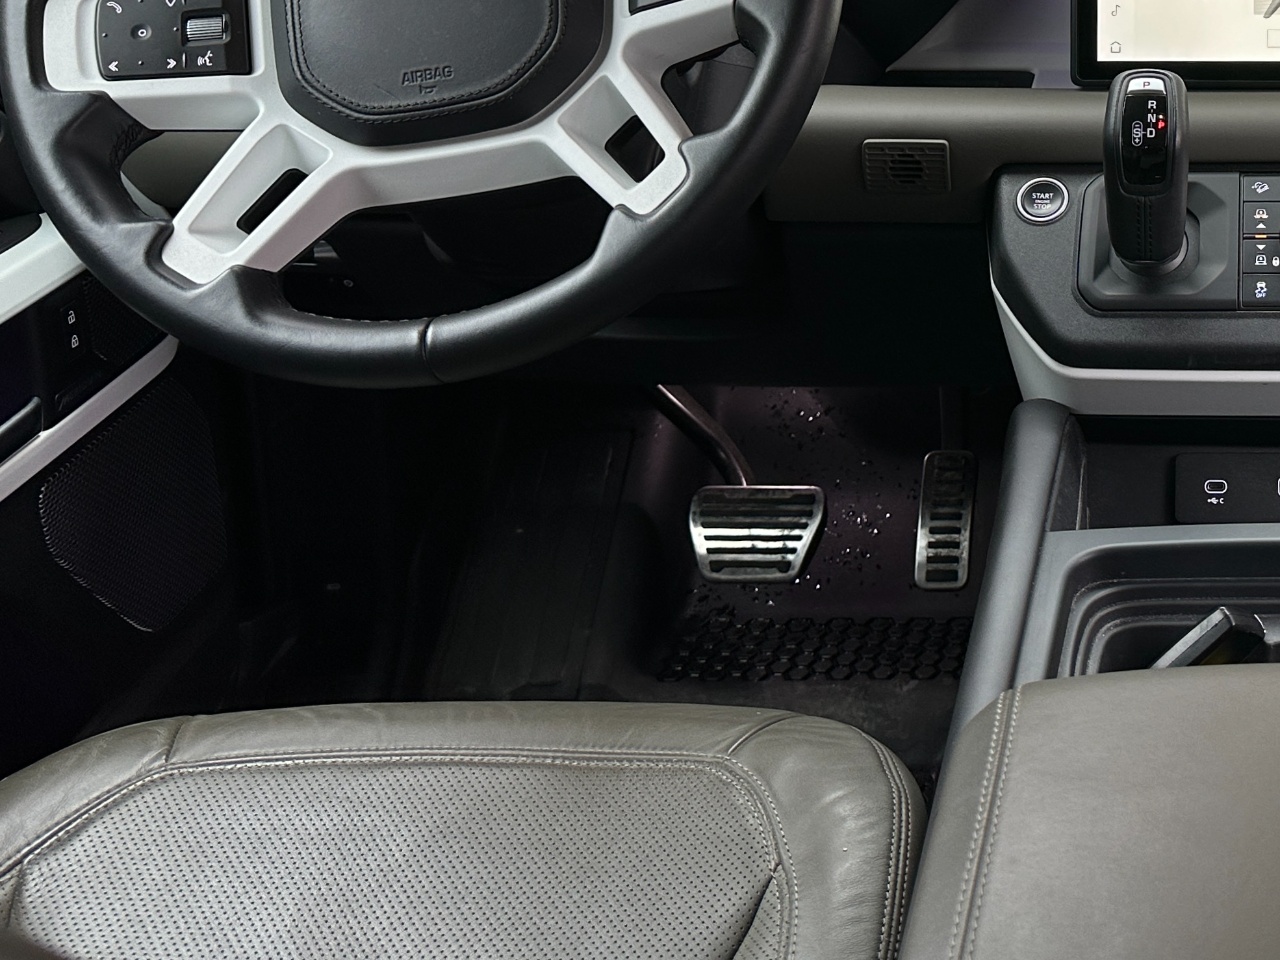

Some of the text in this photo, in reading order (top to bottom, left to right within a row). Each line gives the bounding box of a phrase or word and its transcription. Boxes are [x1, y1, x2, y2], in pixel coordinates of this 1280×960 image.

[401, 65, 454, 86] AIRBAG
[1147, 100, 1157, 109] R
[1147, 113, 1156, 123] N
[1133, 127, 1141, 138] S
[1146, 127, 1156, 138] D
